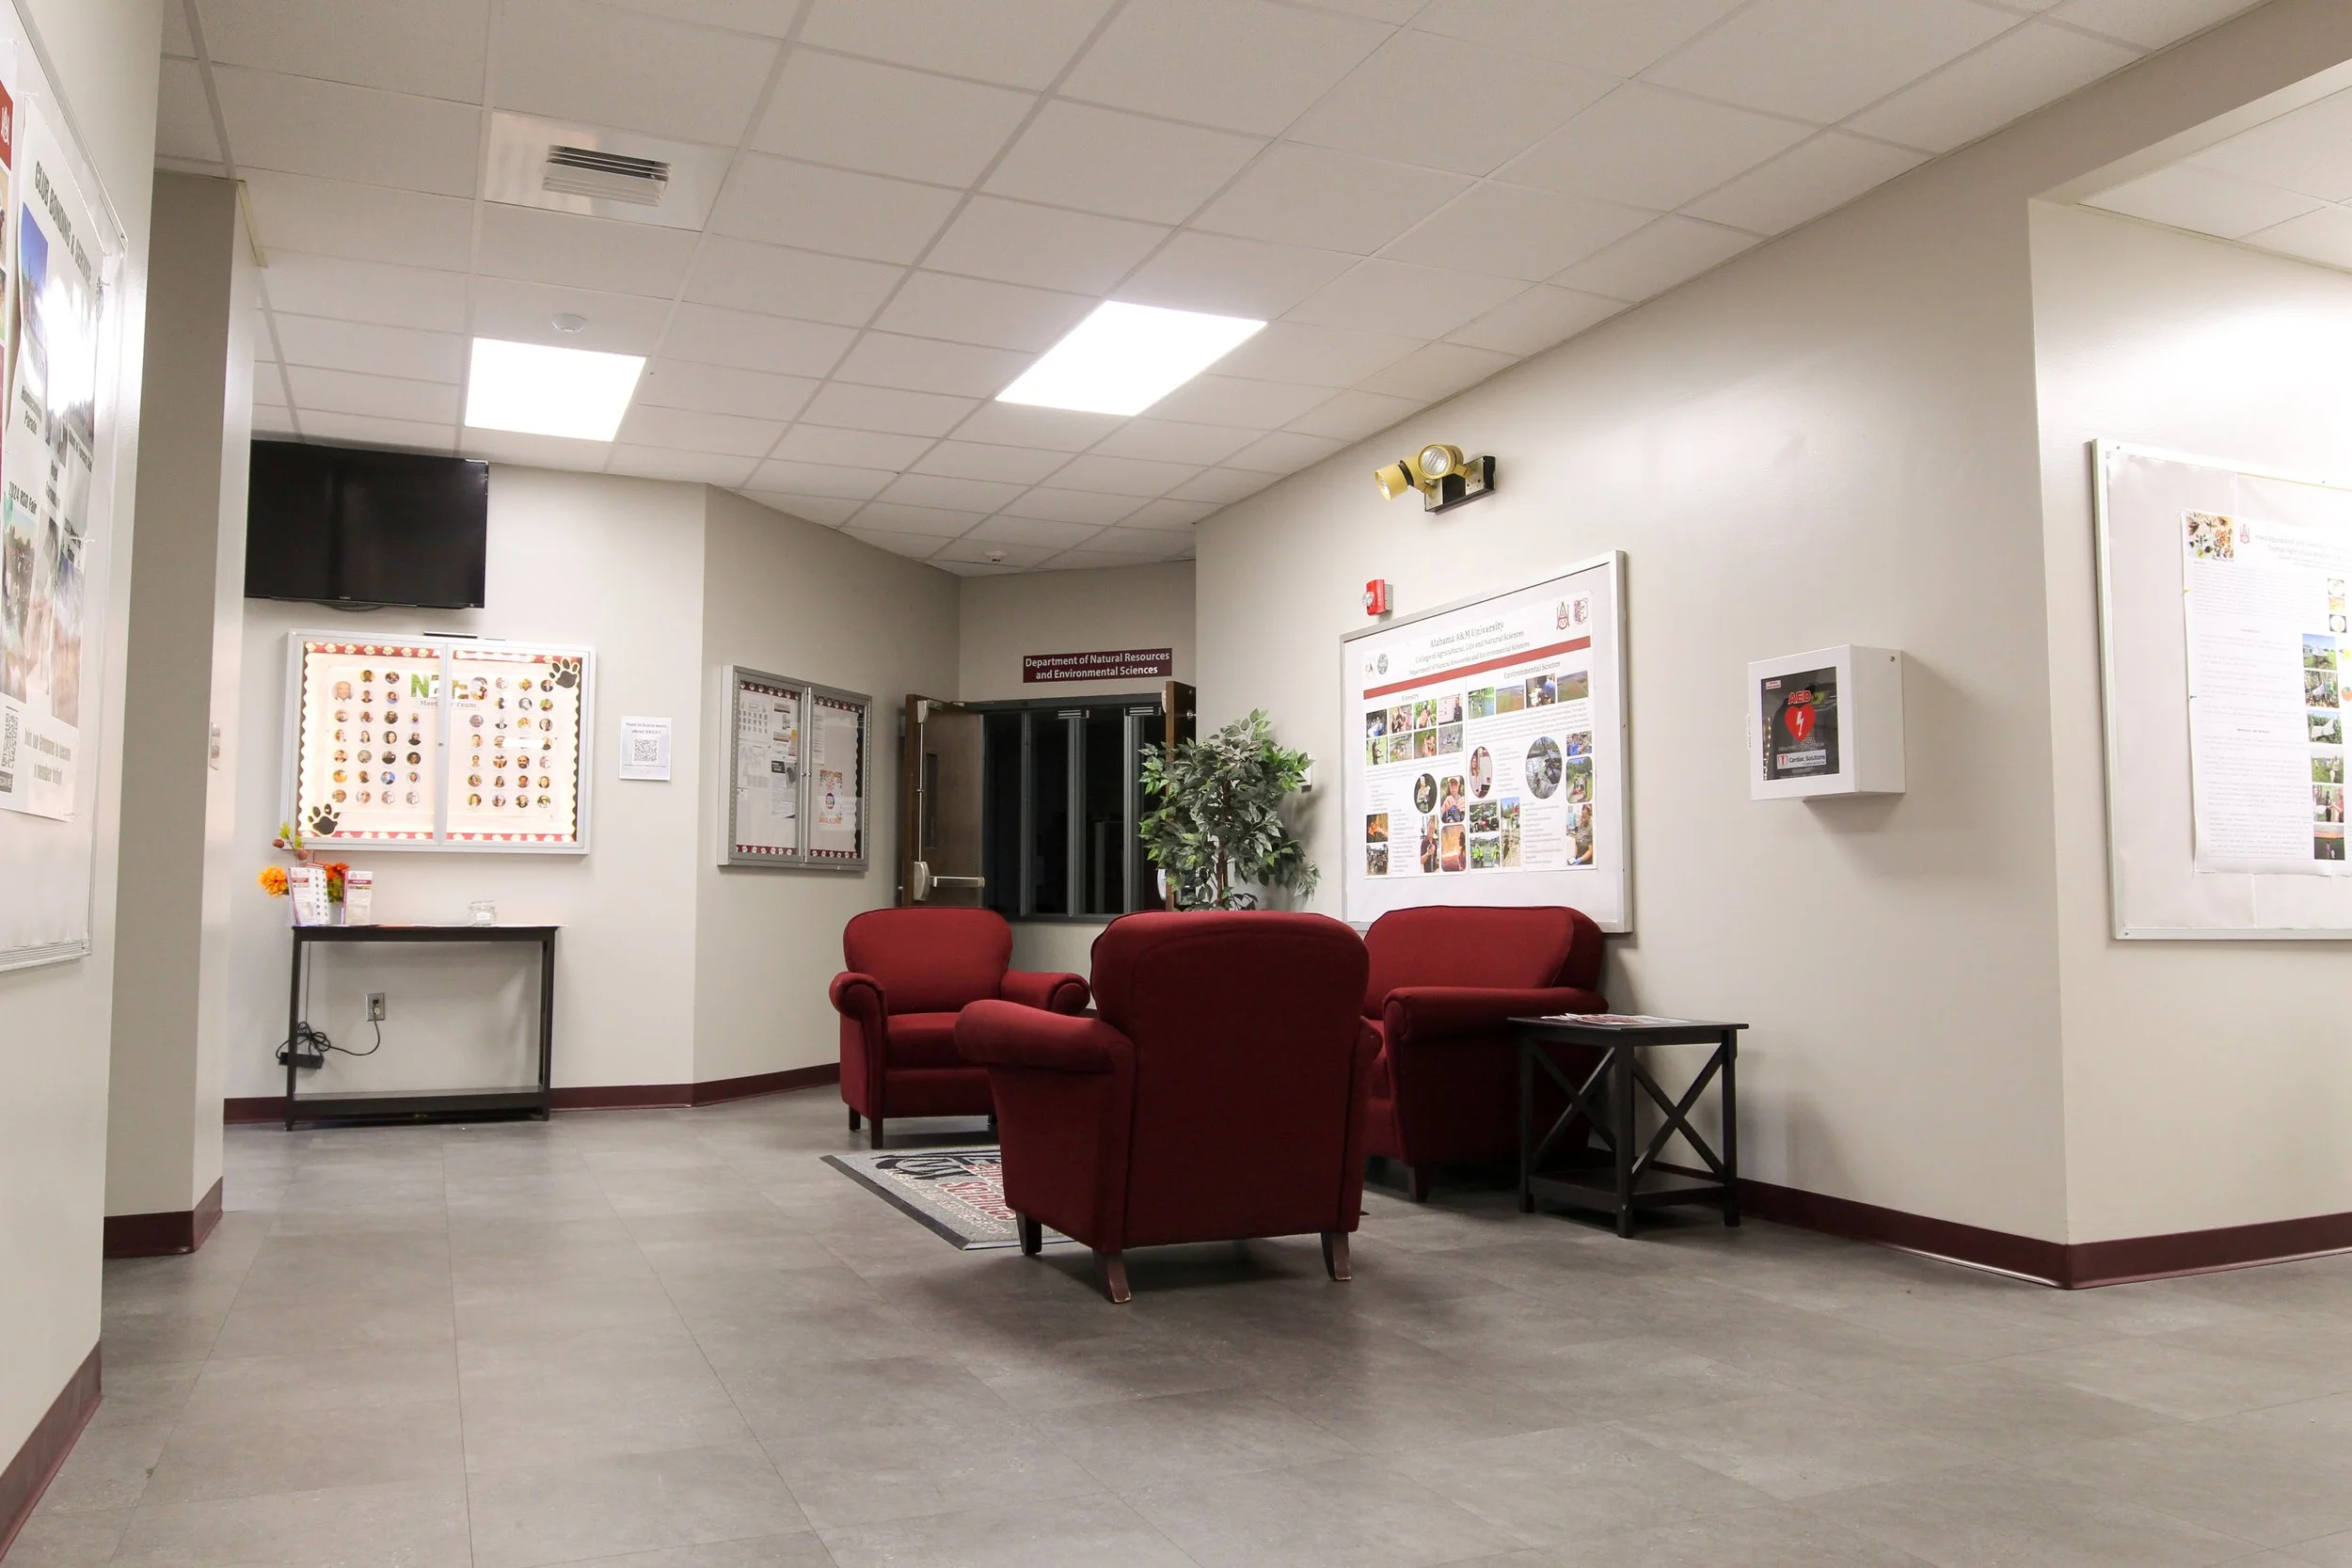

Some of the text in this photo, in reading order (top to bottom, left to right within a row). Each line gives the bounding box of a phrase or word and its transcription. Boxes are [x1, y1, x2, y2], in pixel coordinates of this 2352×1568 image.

[35, 160, 49, 207] CLUB
[8, 481, 19, 504] 2024
[28, 496, 38, 516] Fair
[1430, 620, 1504, 649] Alabama A&M University
[1415, 653, 1431, 664] College
[1466, 641, 1475, 651] Life
[1475, 640, 1484, 648] and
[1484, 635, 1503, 647] Natural
[1503, 630, 1524, 641] Sciences
[1511, 641, 1530, 652] Sciences
[1025, 651, 1169, 669] Department of Natural Resources
[1036, 665, 1158, 679] and Environmental Sciences
[1503, 660, 1561, 679] Environmental Science
[1401, 693, 1420, 703] Forestry
[1788, 689, 1812, 705] AED
[1788, 755, 1805, 764] Cardiac
[1805, 753, 1826, 762] Solutions
